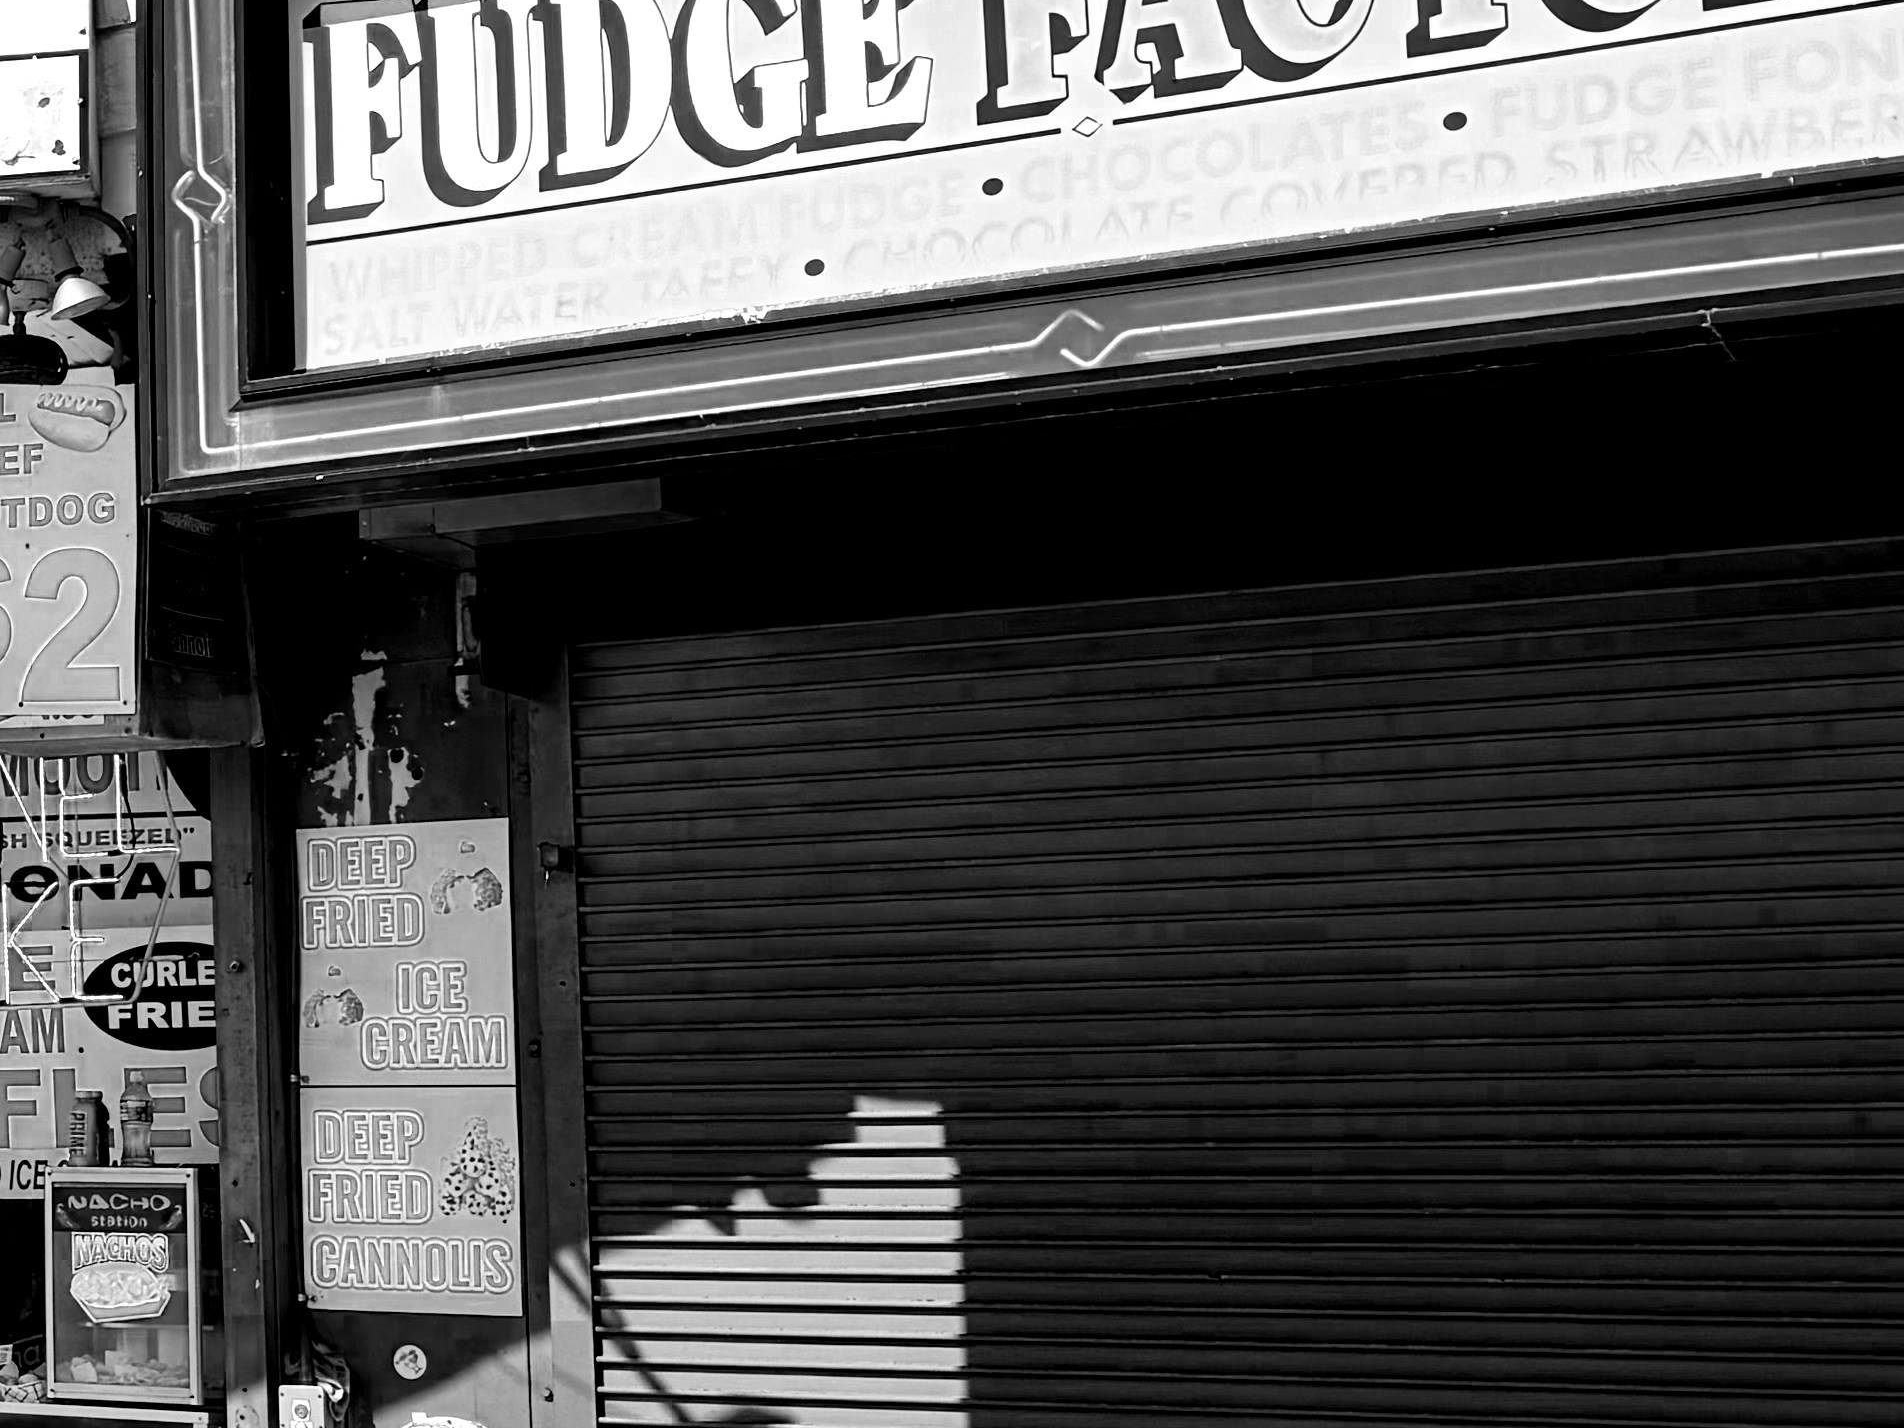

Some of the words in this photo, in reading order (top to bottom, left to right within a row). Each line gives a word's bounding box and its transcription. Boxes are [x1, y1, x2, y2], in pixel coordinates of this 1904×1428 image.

[307, 835, 417, 891] DEEP
[300, 893, 424, 950] FRIED
[395, 961, 468, 1015] ICE
[360, 1015, 508, 1070] CREAM
[313, 1109, 423, 1165] DEEP
[10, 1160, 48, 1189] ICE
[308, 1168, 434, 1224] FRIED
[68, 1193, 171, 1212] NACHO
[91, 1213, 148, 1229] station
[310, 1233, 514, 1293] CANNOLIS
